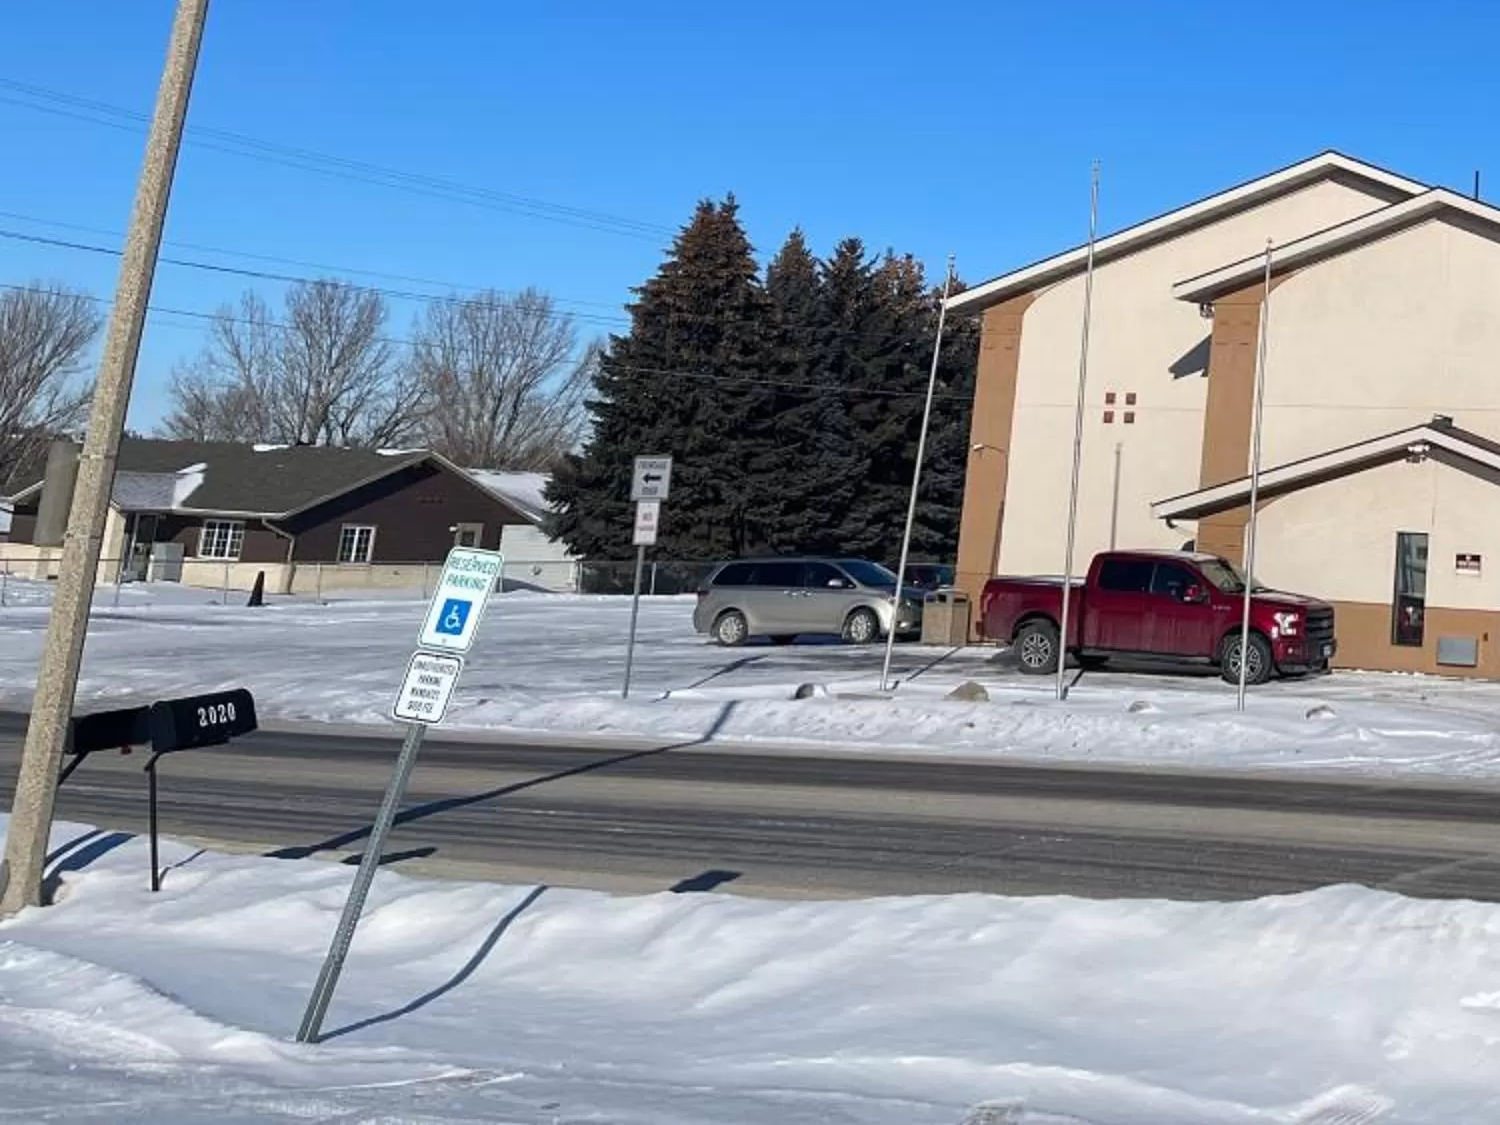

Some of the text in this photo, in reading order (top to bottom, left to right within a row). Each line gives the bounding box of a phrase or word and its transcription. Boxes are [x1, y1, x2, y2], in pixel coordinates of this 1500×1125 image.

[450, 556, 500, 575] RESERVED
[446, 574, 487, 592] PARKING
[198, 702, 237, 727] 2020
